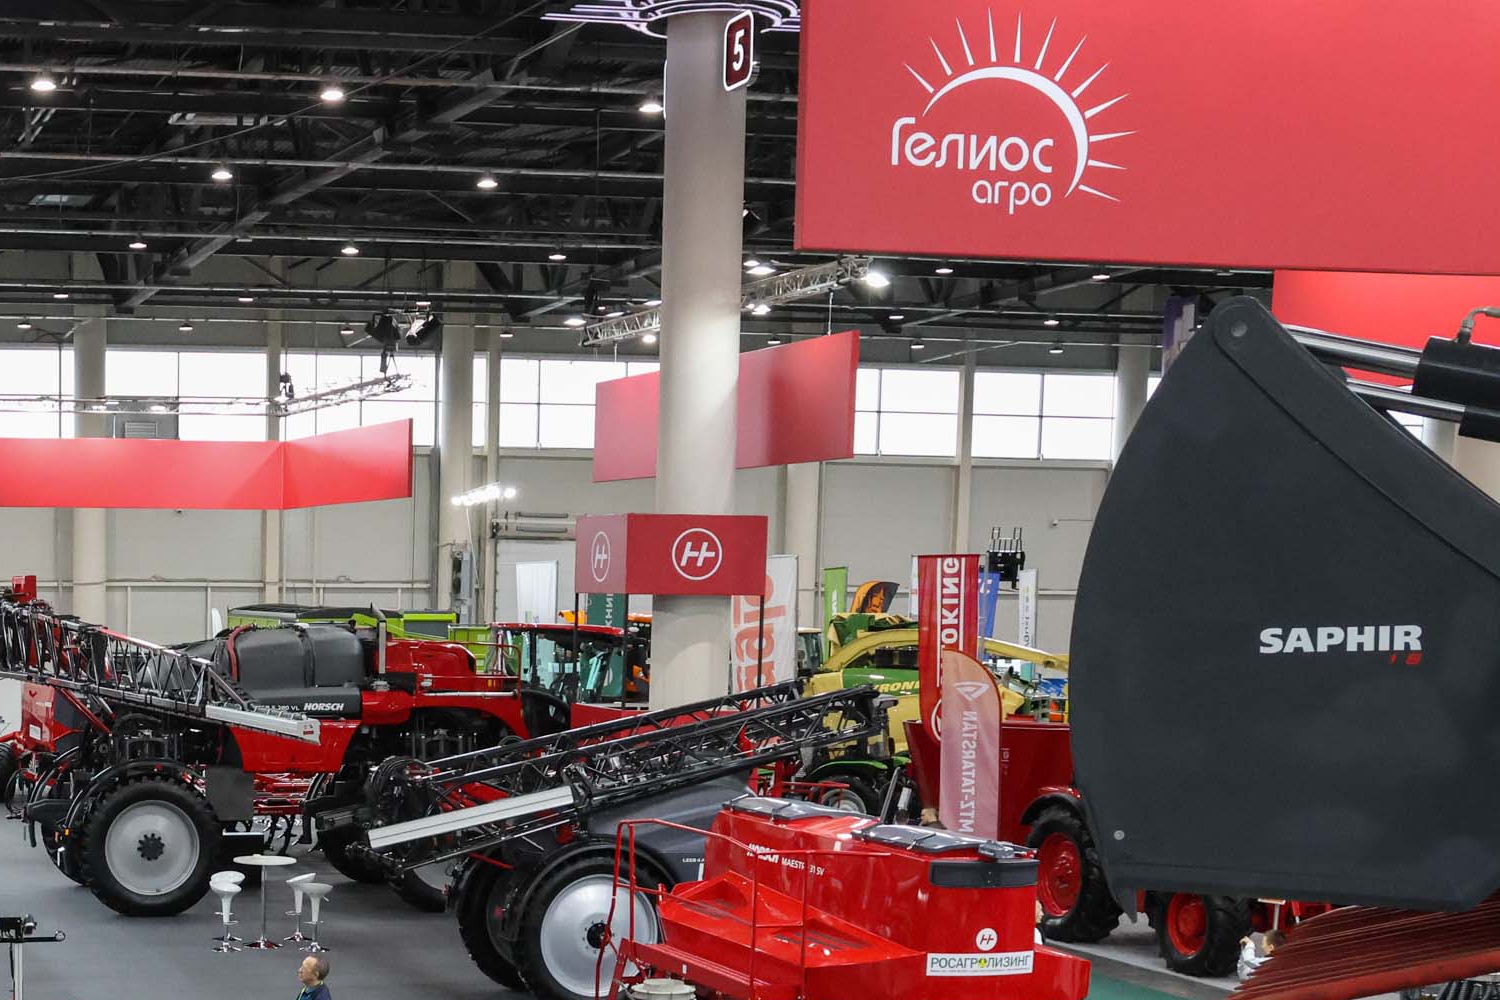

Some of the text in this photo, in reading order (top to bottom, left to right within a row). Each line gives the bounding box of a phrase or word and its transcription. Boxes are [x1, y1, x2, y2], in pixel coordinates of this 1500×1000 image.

[733, 29, 745, 71] 5
[891, 116, 1054, 174] Гелиос
[972, 179, 1051, 215] агро
[1259, 625, 1422, 654] SAPHIR
[303, 703, 344, 711] HORSCH
[781, 857, 805, 870] MAESTR
[931, 955, 1031, 968] РОСАГРОЛИЗИНГ
